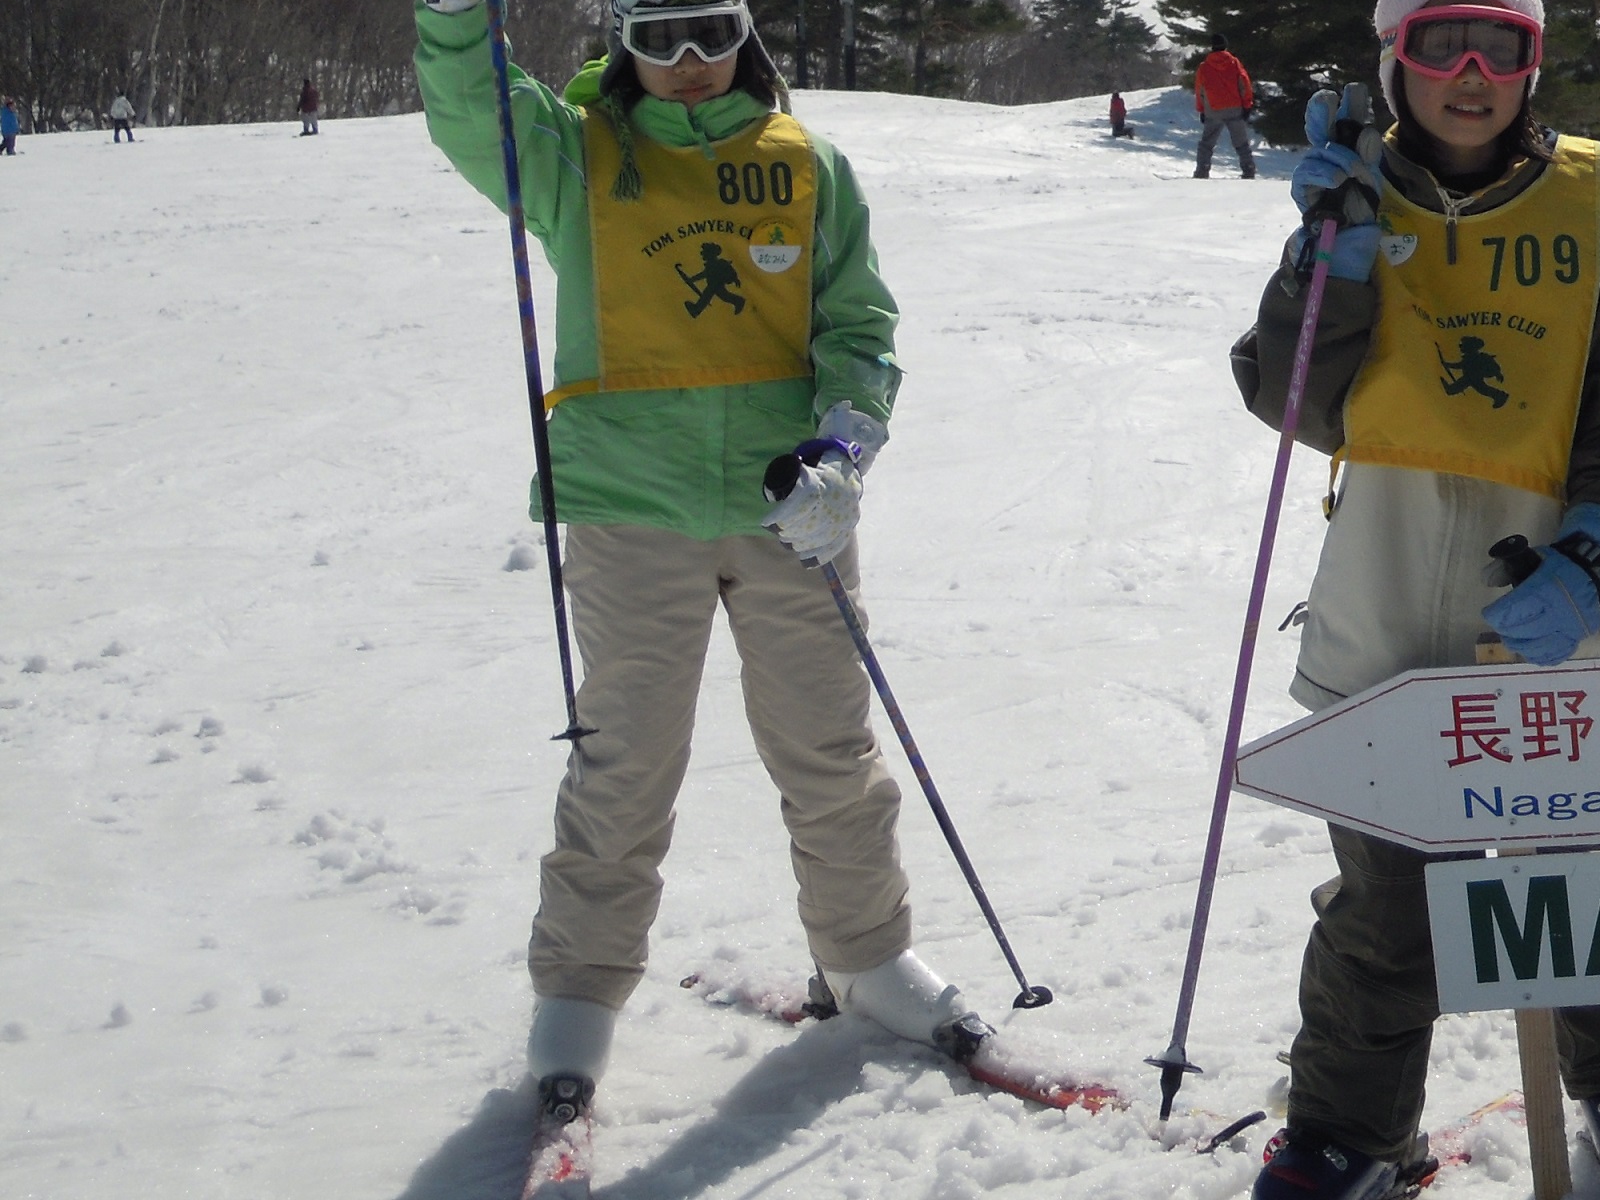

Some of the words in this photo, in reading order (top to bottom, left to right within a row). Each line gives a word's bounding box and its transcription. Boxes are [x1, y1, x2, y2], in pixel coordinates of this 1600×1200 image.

[717, 161, 793, 206] 800
[641, 232, 675, 257] TOM
[677, 220, 734, 239] SAWYER
[1482, 234, 1580, 292] 709
[1436, 312, 1501, 329] SAWYER
[1507, 315, 1547, 339] CLUB
